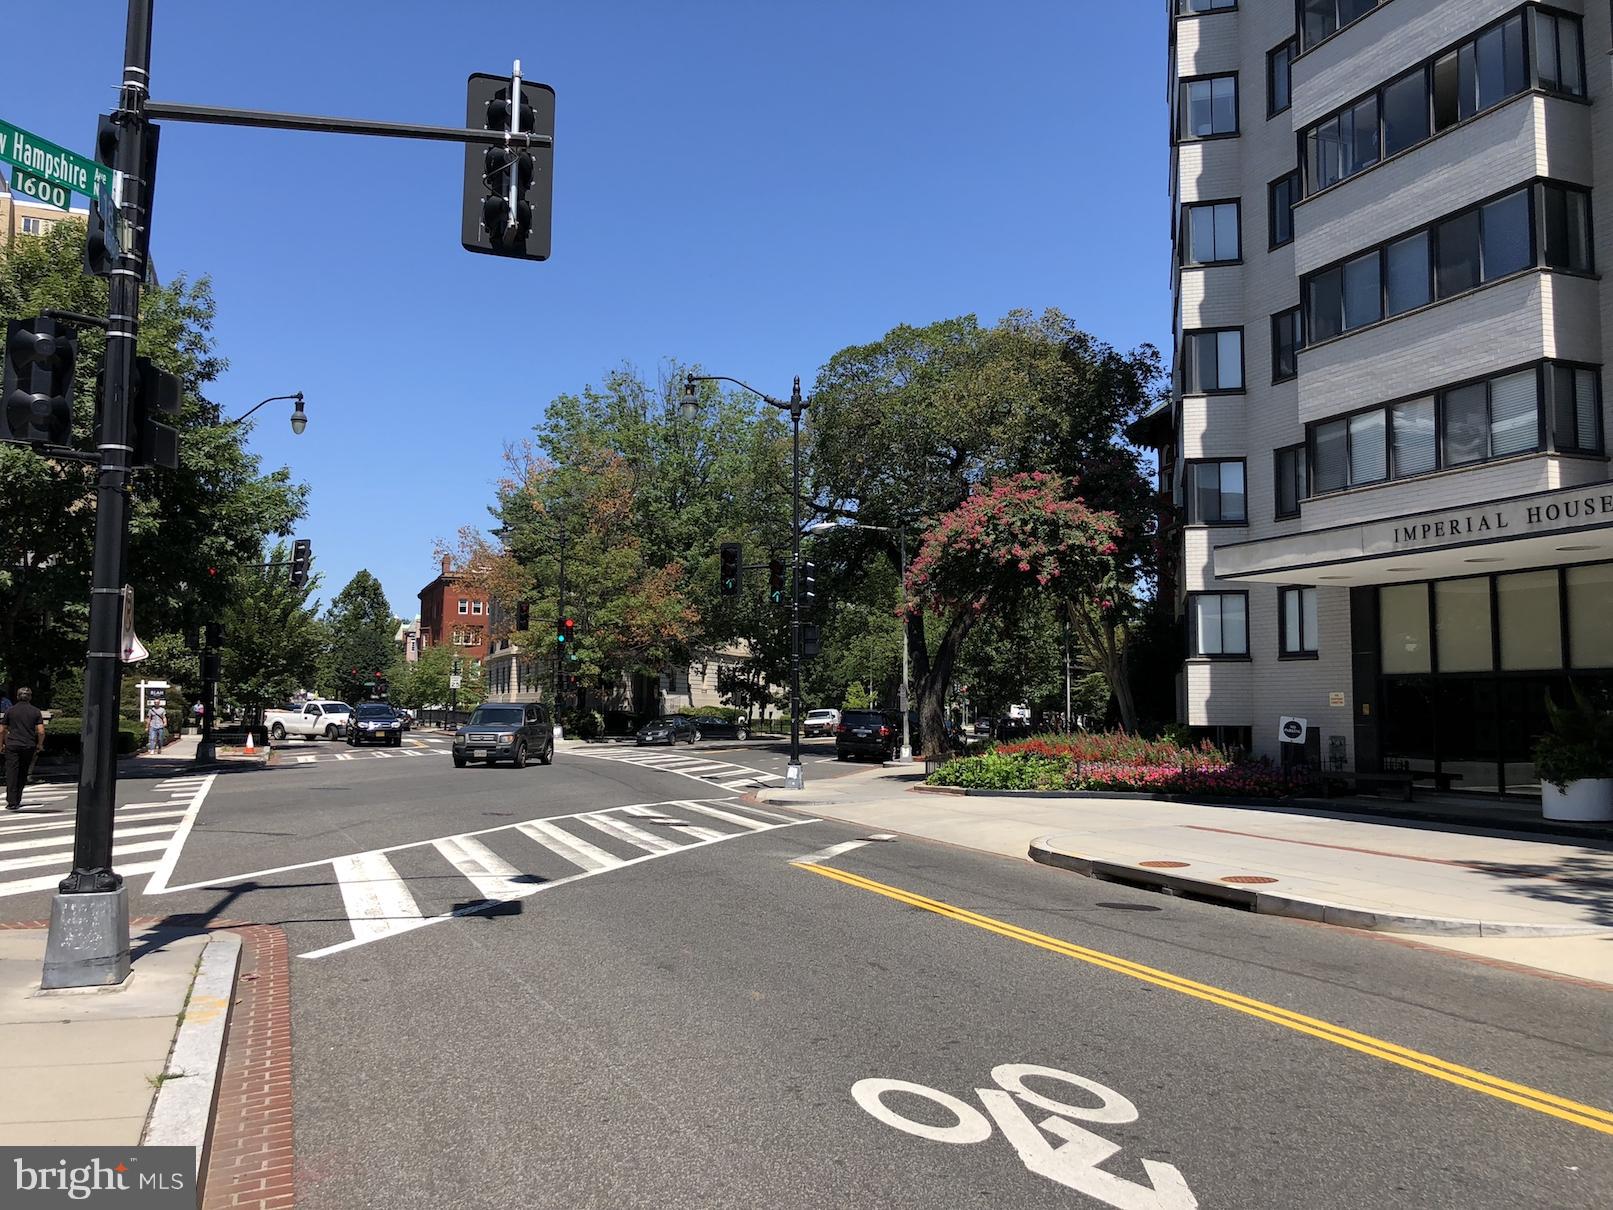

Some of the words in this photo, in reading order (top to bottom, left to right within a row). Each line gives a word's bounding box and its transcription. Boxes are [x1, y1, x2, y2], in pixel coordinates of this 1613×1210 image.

[12, 131, 87, 189] Hampshire
[16, 172, 65, 207] 1600
[1394, 512, 1508, 543] IMPERIAL
[1526, 495, 1613, 524] HOUSE
